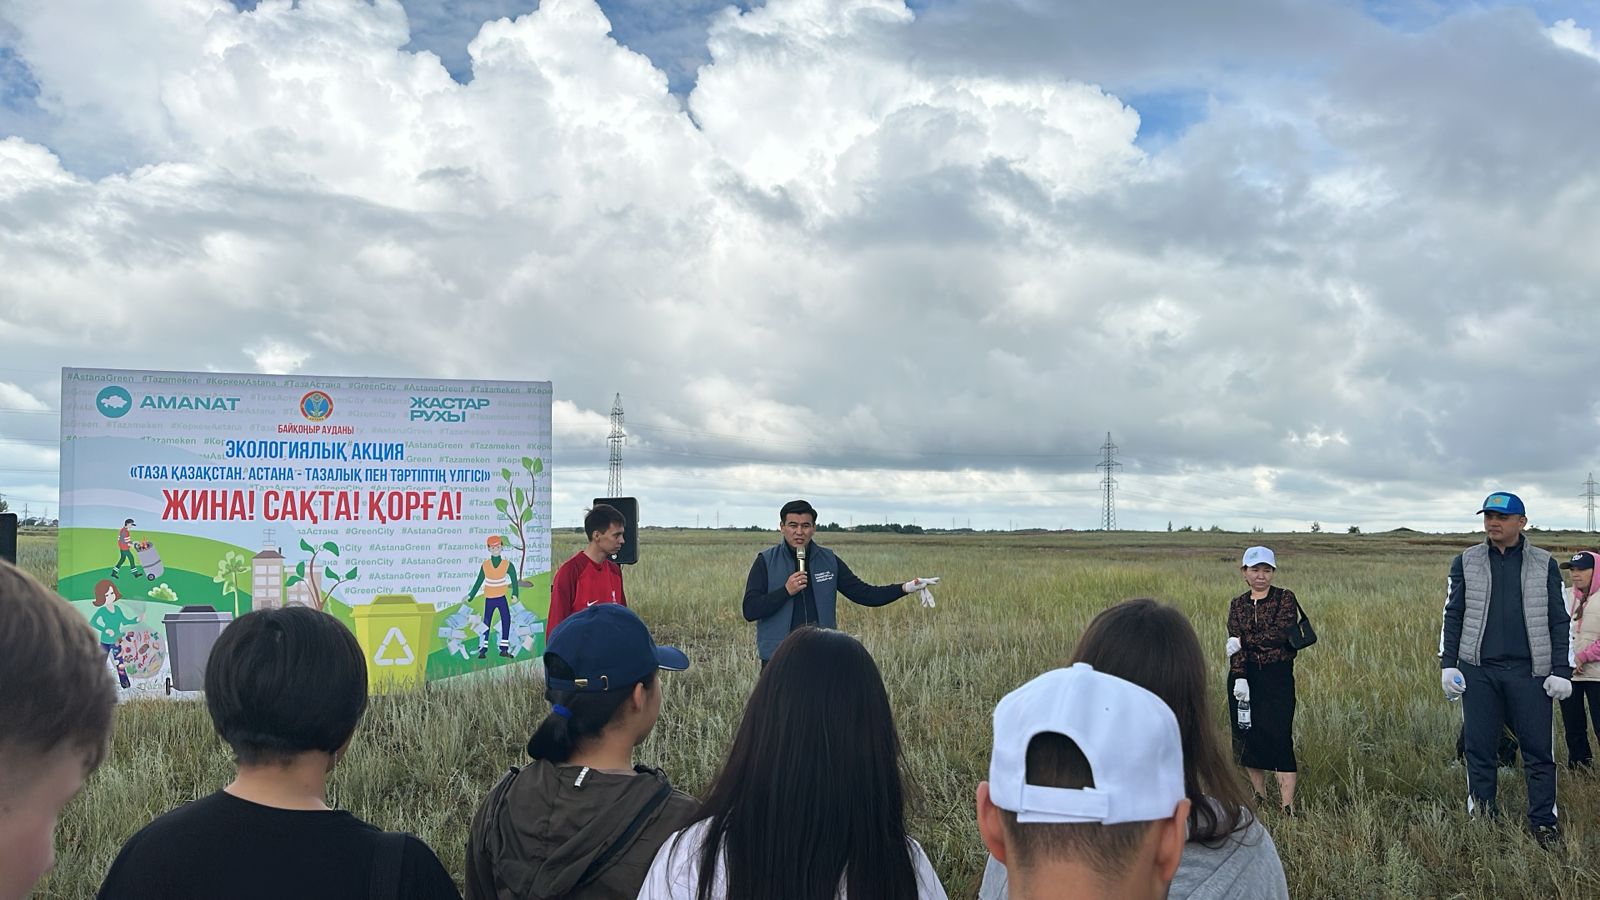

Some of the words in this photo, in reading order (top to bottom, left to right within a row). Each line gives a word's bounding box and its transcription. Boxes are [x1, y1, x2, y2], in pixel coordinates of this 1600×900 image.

[67, 373, 134, 383] #AstanaGreen
[142, 375, 199, 384] #Tazameken
[349, 382, 397, 392] #GreenCity
[404, 383, 464, 393] #AstanaGreen
[470, 386, 521, 394] #Tazameken
[140, 396, 241, 411] AMANAT
[410, 397, 490, 410] ЖАСТАР
[410, 410, 466, 422] РУХЫ
[277, 424, 319, 435] БАЙҚОҢЫР
[321, 425, 355, 436] АУДАНЫ
[225, 440, 347, 462] ЭКОЛОГИЯЛЫҚ
[351, 443, 405, 462] АКЦИЯ
[470, 443, 520, 451] #Tazameken
[439, 456, 490, 465] #Tazameken
[130, 465, 168, 479] «ТАЗА
[171, 466, 245, 481] ҚАЗАҚСТАН.
[248, 467, 294, 480] АСТАНА
[305, 468, 362, 482] ТАЗАЛЫҚ
[365, 469, 388, 481] ПЕН
[162, 489, 255, 521] ЖИНА!
[263, 490, 360, 524] САҚТА!
[368, 491, 462, 525] ҚОРҒА!
[345, 527, 394, 537] #GreenCity
[401, 527, 462, 536] #AstanaGreen
[369, 543, 431, 552] #AstanaGreen
[345, 558, 394, 568] #GreenCity
[400, 558, 461, 566] #AstanaGreen
[368, 571, 430, 580] #AstanaGreen
[344, 585, 393, 595] #GreenCity
[400, 584, 461, 593] #AstanaGreen
